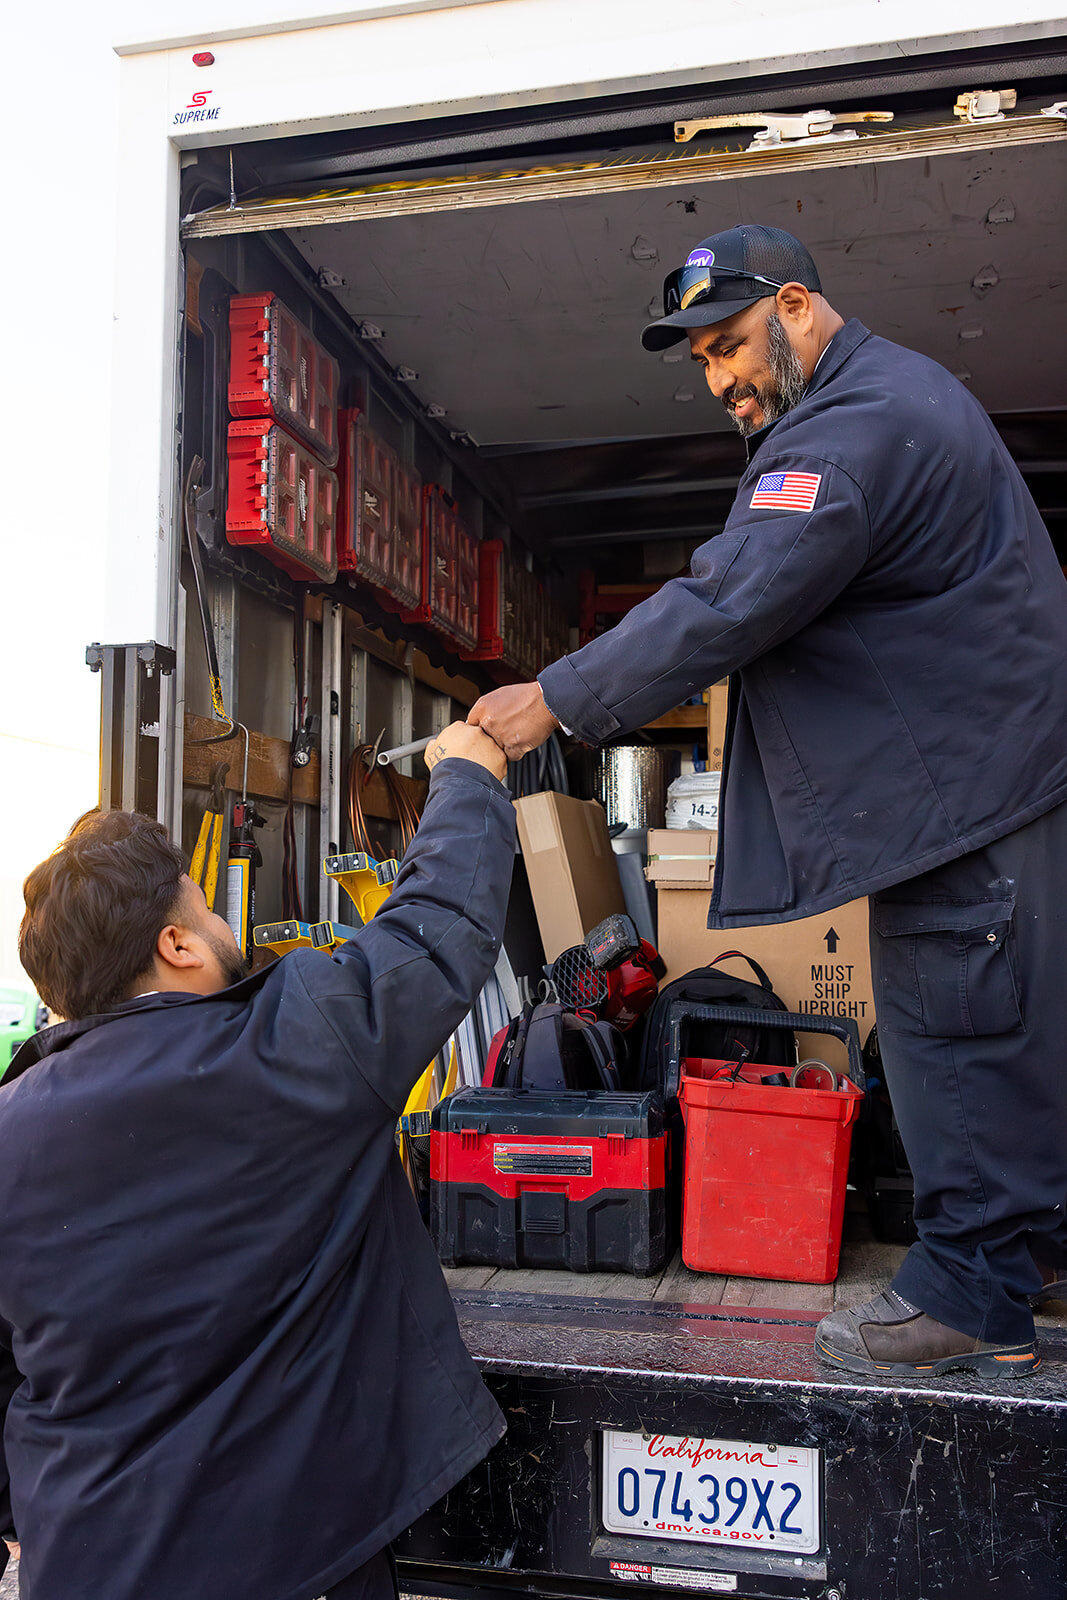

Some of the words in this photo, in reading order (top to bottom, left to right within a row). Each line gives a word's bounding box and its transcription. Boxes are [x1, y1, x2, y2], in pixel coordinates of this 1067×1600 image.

[172, 107, 221, 125] SUPREME
[811, 965, 854, 981] MUST
[815, 983, 851, 999] SHIP
[799, 1000, 868, 1018] UPRIGHT
[647, 1434, 778, 1468] California
[617, 1467, 803, 1535] 07439X2
[655, 1521, 764, 1541] dmv.ca.gov
[619, 1562, 648, 1573] DANGER
